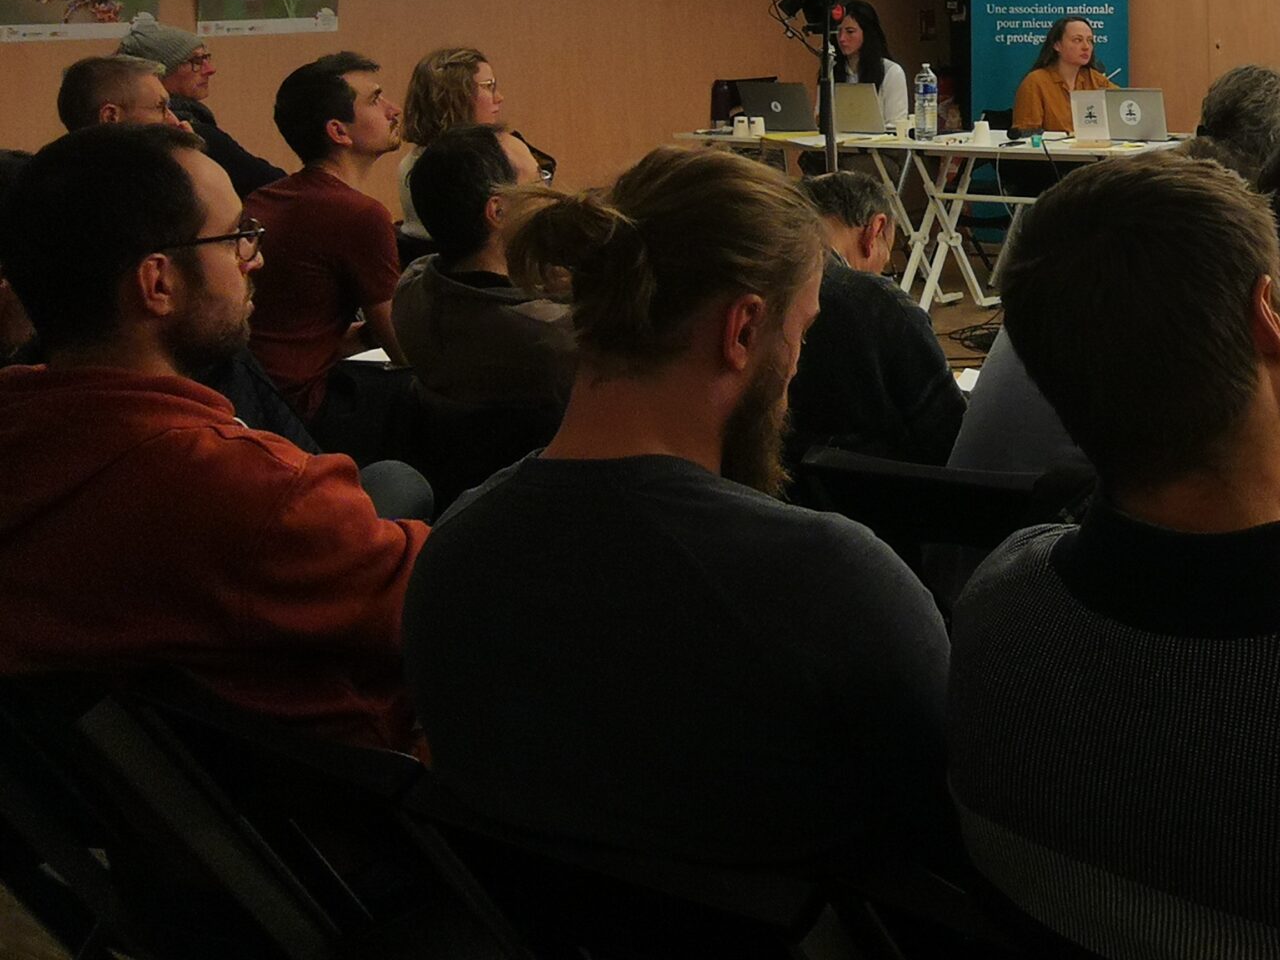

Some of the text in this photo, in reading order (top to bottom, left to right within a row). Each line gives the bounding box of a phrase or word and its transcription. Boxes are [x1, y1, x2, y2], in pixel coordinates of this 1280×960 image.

[986, 3, 1115, 14] Une association nationale
[996, 18, 1054, 31] pour mieux
[995, 33, 1004, 42] et
